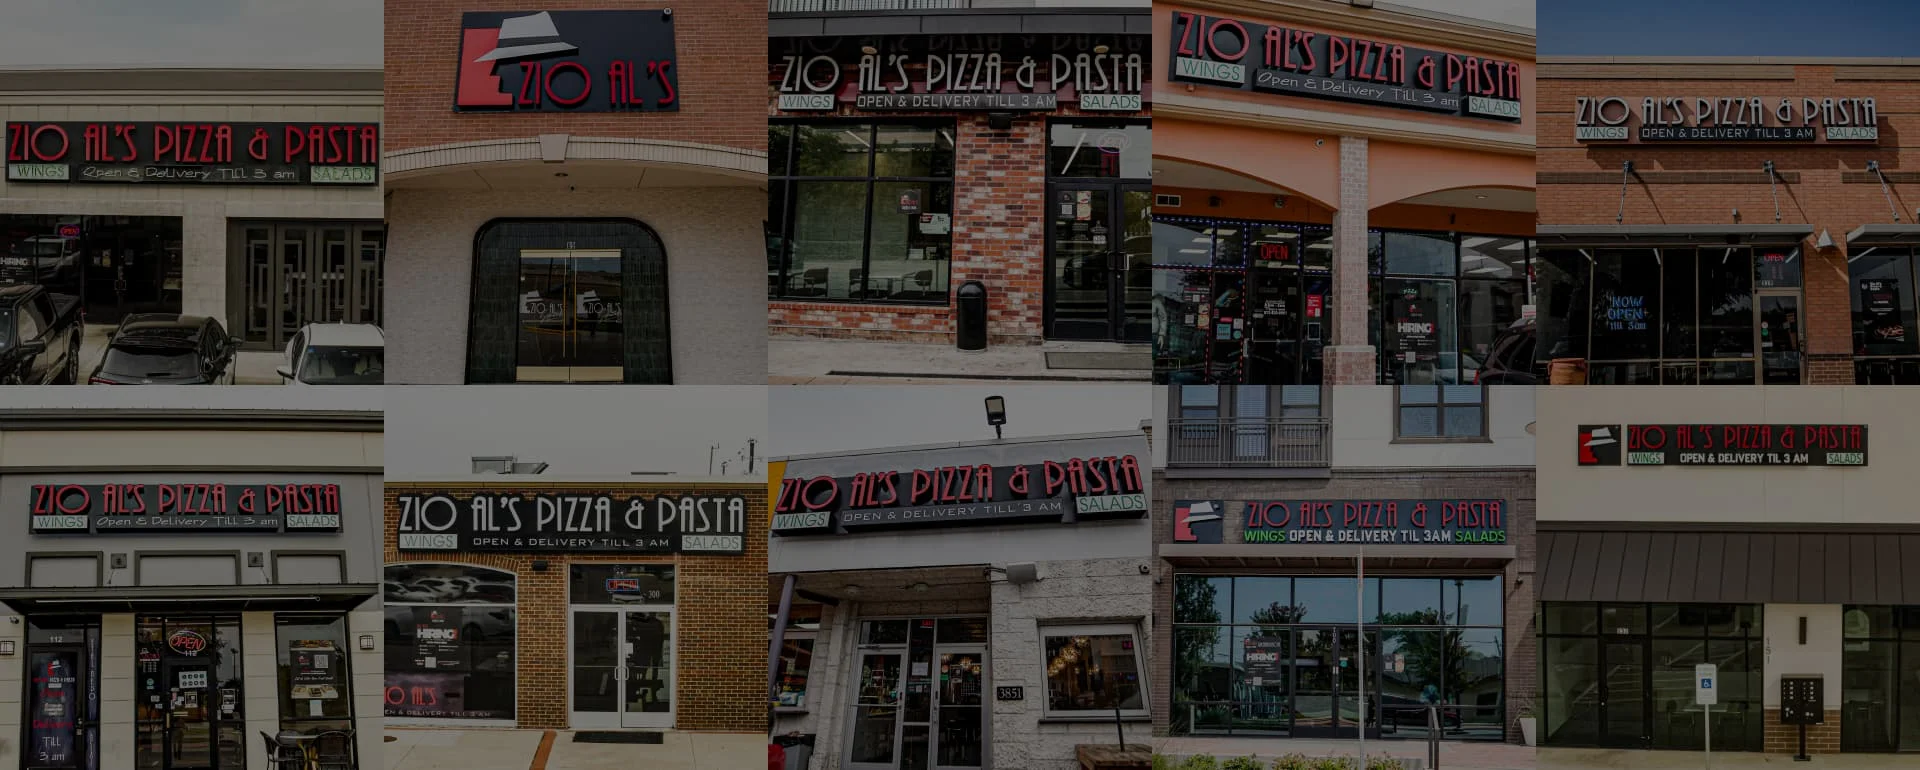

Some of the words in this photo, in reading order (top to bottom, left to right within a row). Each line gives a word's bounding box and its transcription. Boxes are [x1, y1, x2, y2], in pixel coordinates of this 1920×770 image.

[1176, 12, 1251, 61] ZIO
[1263, 26, 1317, 73] AL'S
[1327, 35, 1406, 84] PIZZA
[1416, 56, 1436, 89] &
[1444, 53, 1520, 100] PASTA
[781, 54, 840, 92] ZIO
[858, 53, 909, 93] AL'S
[926, 52, 1001, 94] PIZZA
[1015, 55, 1037, 89] &
[1050, 52, 1142, 93] PASTA
[1180, 59, 1242, 81] WINGS
[518, 60, 593, 106] ZIO
[607, 60, 676, 106] AL'S
[1257, 71, 1299, 89] Open
[1303, 78, 1318, 90] &
[1422, 93, 1436, 103] 3
[1439, 98, 1459, 108] am
[782, 95, 832, 108] WINGS
[857, 95, 894, 109] OPEN
[897, 95, 909, 108] &
[911, 95, 981, 109] DELIVERY
[986, 95, 1016, 108] TILL
[1021, 95, 1031, 108] 3
[1034, 95, 1057, 108] AM
[1082, 95, 1141, 109] SALADS
[1471, 99, 1520, 117] SALADS
[1577, 97, 1630, 126] ZIO
[1641, 97, 1684, 126] AL'S
[1696, 97, 1764, 127] PIZZA
[1775, 97, 1793, 123] &
[1801, 97, 1878, 127] PASTA
[1580, 127, 1625, 140] WINGS
[1642, 127, 1675, 140] OPEN
[1678, 127, 1688, 140] &
[1690, 127, 1749, 140] DELIVERY
[1754, 127, 1780, 140] TILL
[1783, 127, 1793, 140] 3
[1795, 127, 1814, 140] AM
[1828, 127, 1877, 140] SALADS
[7, 123, 71, 162] ZIO
[83, 123, 137, 163] AL'S
[152, 123, 233, 164] PIZZA
[247, 127, 270, 161] &
[283, 124, 378, 165] PASTA
[17, 166, 66, 179] WINGS
[253, 167, 267, 178] 3
[273, 170, 295, 179] am
[312, 167, 374, 181] SALADS
[1260, 243, 1290, 260] OPEN
[1607, 308, 1645, 321] OPEN
[1628, 425, 1667, 449] ZIO
[1677, 425, 1714, 449] AL'S
[1724, 425, 1772, 449] PIZZA
[1779, 425, 1796, 449] &
[1804, 425, 1861, 449] PASTA
[1631, 453, 1662, 465] WINGS
[1679, 453, 1706, 464] OPEN
[1707, 453, 1716, 464] &
[1717, 453, 1764, 464] DELIVERY
[1766, 453, 1782, 464] TIL
[1782, 453, 1792, 464] 3
[1793, 453, 1809, 464] AM
[1827, 453, 1863, 465] SALADS
[775, 475, 840, 513] ZIO
[849, 470, 899, 509] AL'S
[910, 463, 993, 506] PIZZA
[1008, 465, 1031, 497] &
[1043, 453, 1145, 496] PASTA
[34, 484, 92, 514] ZIO
[103, 483, 146, 515] AL'S
[158, 483, 227, 515] PIZZA
[238, 487, 256, 514] &
[265, 483, 339, 515] PASTA
[1078, 494, 1144, 513] SALADS
[400, 496, 458, 532] ZIO
[471, 496, 521, 532] AL'S
[536, 496, 611, 533] PIZZA
[624, 498, 645, 530] &
[657, 496, 744, 533] PASTA
[843, 510, 882, 524] OPEN
[887, 511, 897, 521] &
[904, 505, 976, 520] DELIVERY
[984, 503, 1016, 515] TILL
[1022, 502, 1033, 513] 3
[1038, 501, 1062, 512] AM
[1248, 502, 1291, 528] ZIO
[1299, 502, 1333, 528] AL'S
[1343, 502, 1398, 528] PIZZA
[1411, 502, 1428, 528] &
[1442, 502, 1501, 528] PASTA
[38, 516, 85, 529] WINGS
[96, 515, 132, 528] Open
[243, 516, 256, 528] 3
[260, 519, 279, 528] am
[288, 516, 338, 529] SALADS
[776, 513, 828, 530] WINGS
[404, 534, 455, 549] WINGS
[473, 536, 510, 548] OPEN
[514, 536, 524, 548] &
[528, 537, 597, 549] DELIVERY
[601, 537, 631, 549] TILL
[634, 537, 647, 548] 3
[648, 538, 670, 549] AM
[681, 536, 742, 551] SALADS
[1244, 530, 1286, 543] WINGS
[1289, 530, 1322, 543] OPEN
[1325, 530, 1336, 543] &
[1338, 530, 1397, 543] DELIVERY
[1400, 530, 1420, 543] TIL
[1423, 530, 1452, 543] 3AM
[1455, 530, 1507, 543] SALADS
[170, 635, 203, 650] OPEN
[998, 687, 1023, 700] 3851
[39, 751, 49, 761] 3
[52, 752, 66, 761] am
